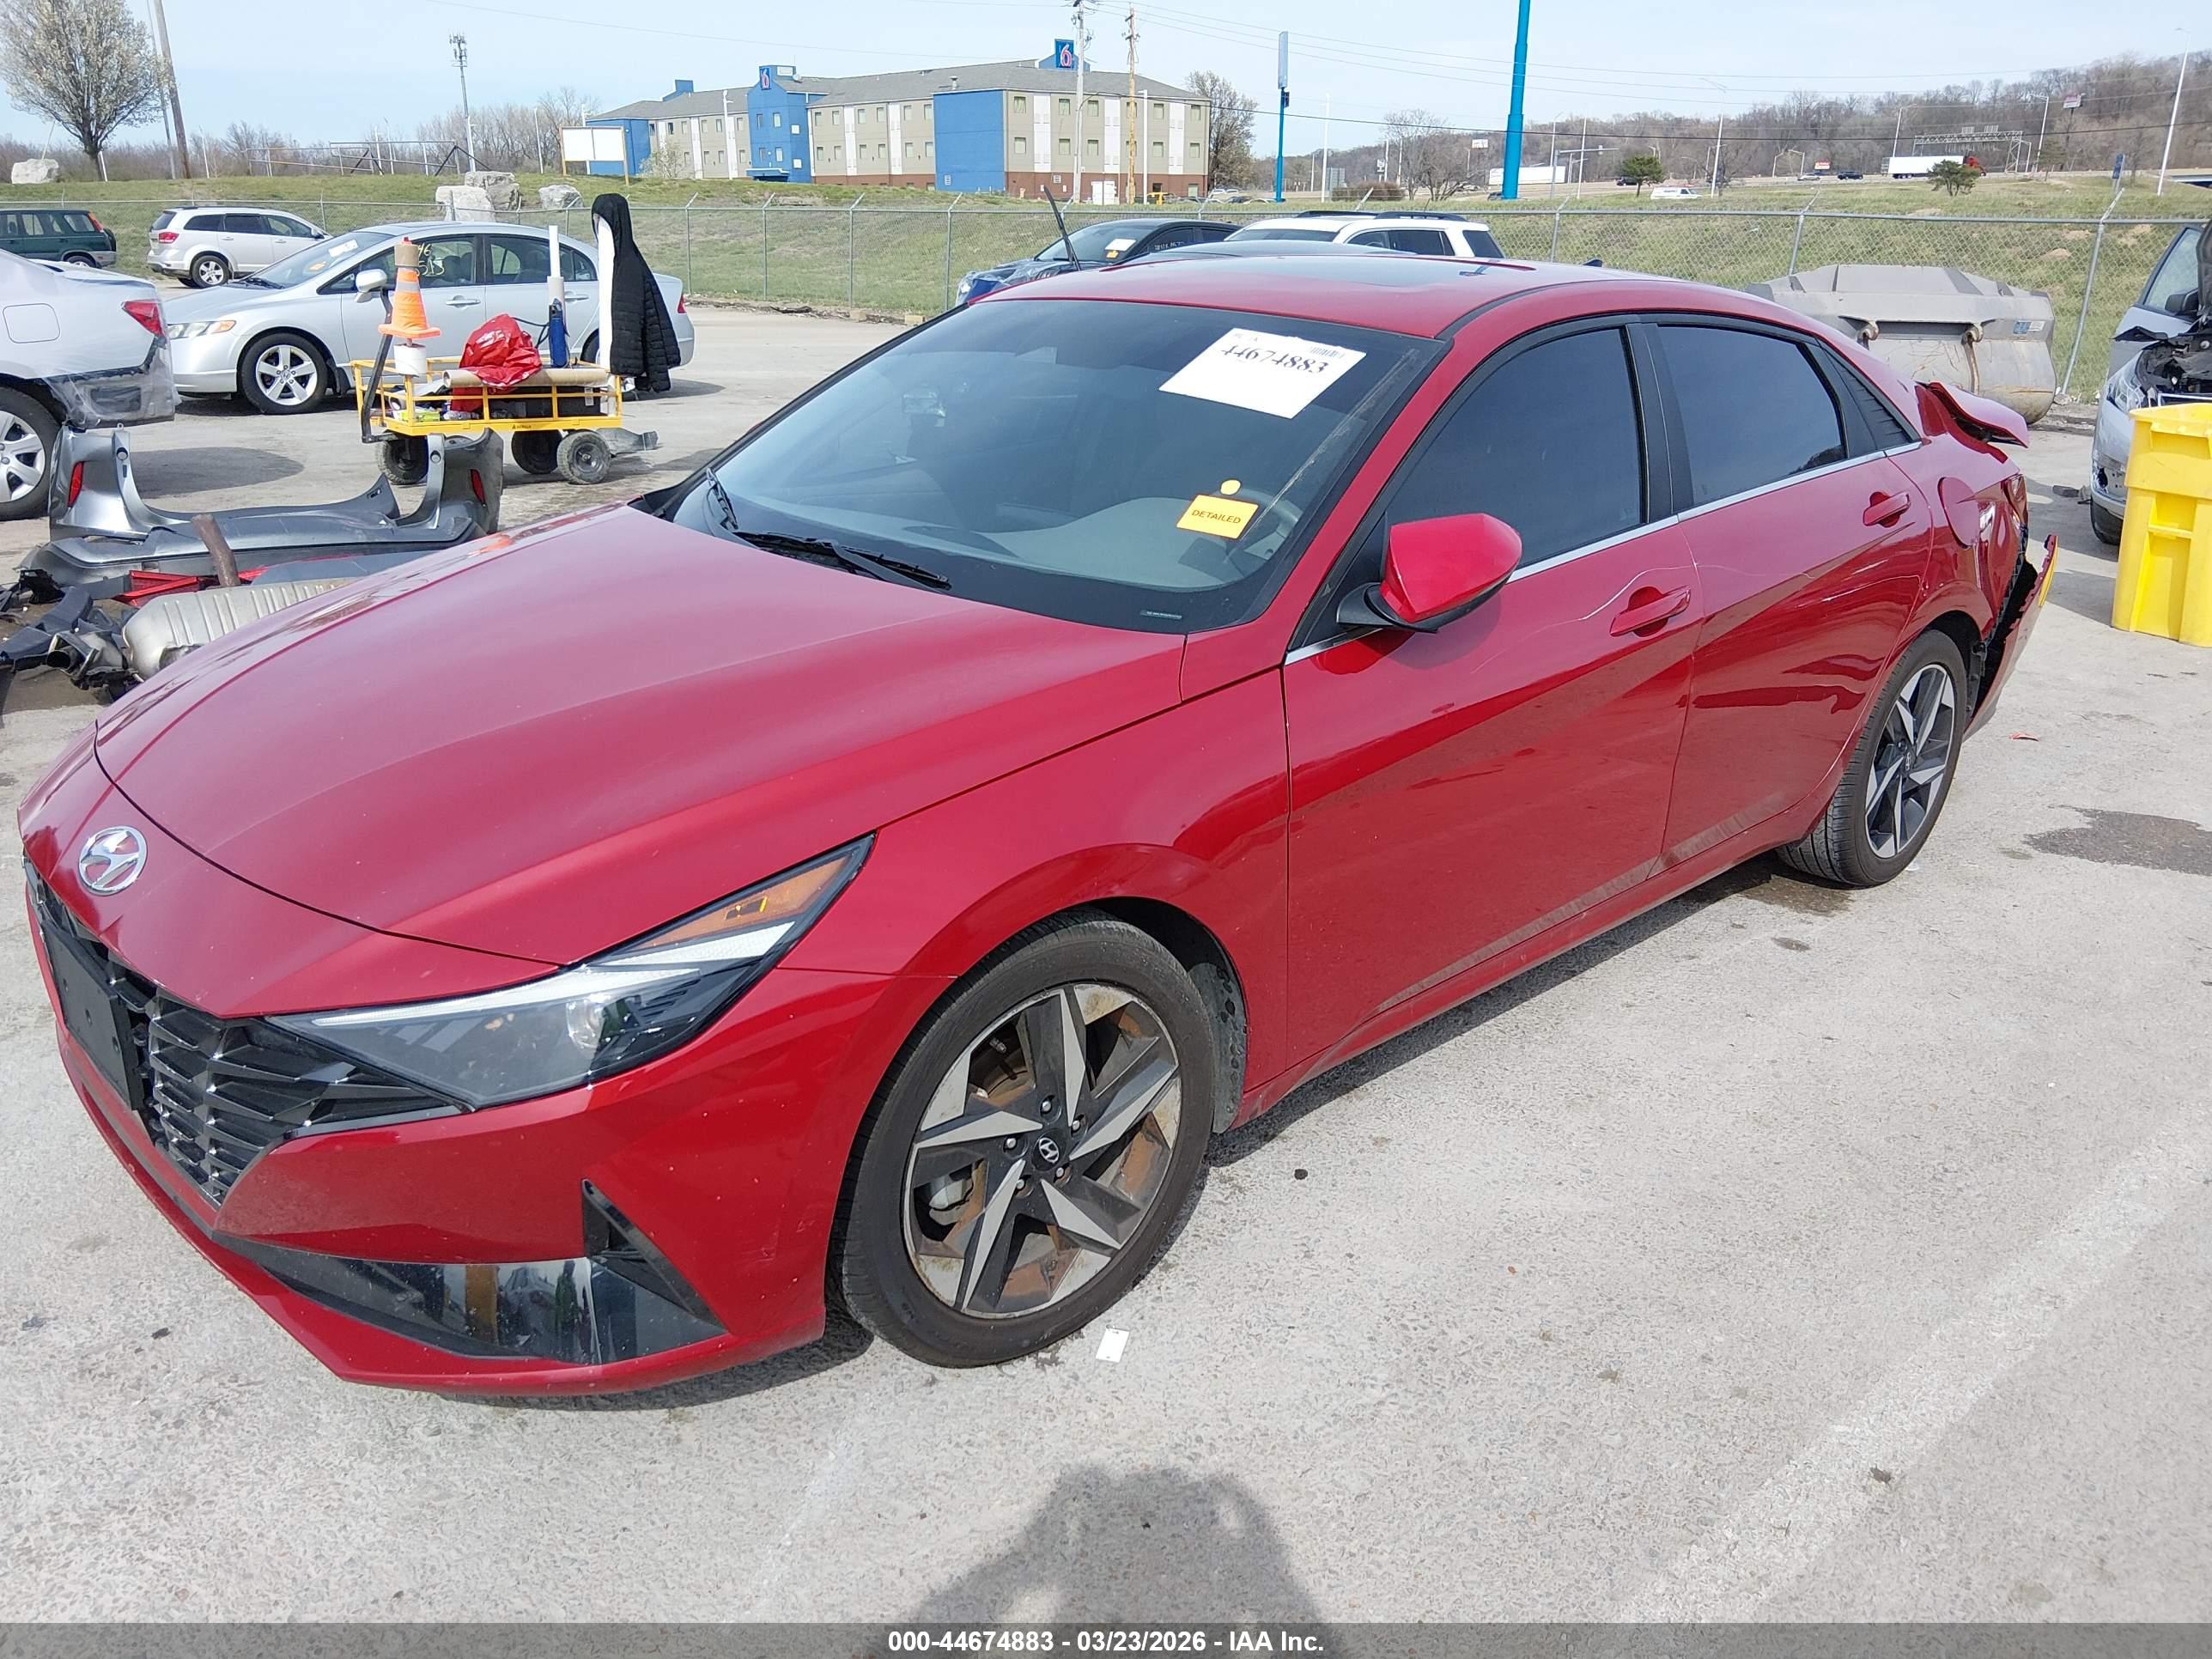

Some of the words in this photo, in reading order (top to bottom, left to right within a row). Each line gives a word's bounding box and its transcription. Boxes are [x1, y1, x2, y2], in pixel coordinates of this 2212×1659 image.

[1060, 43, 1073, 67] 6
[760, 68, 769, 89] 6
[1221, 344, 1329, 374] 44674883
[1191, 509, 1242, 524] DETAILED
